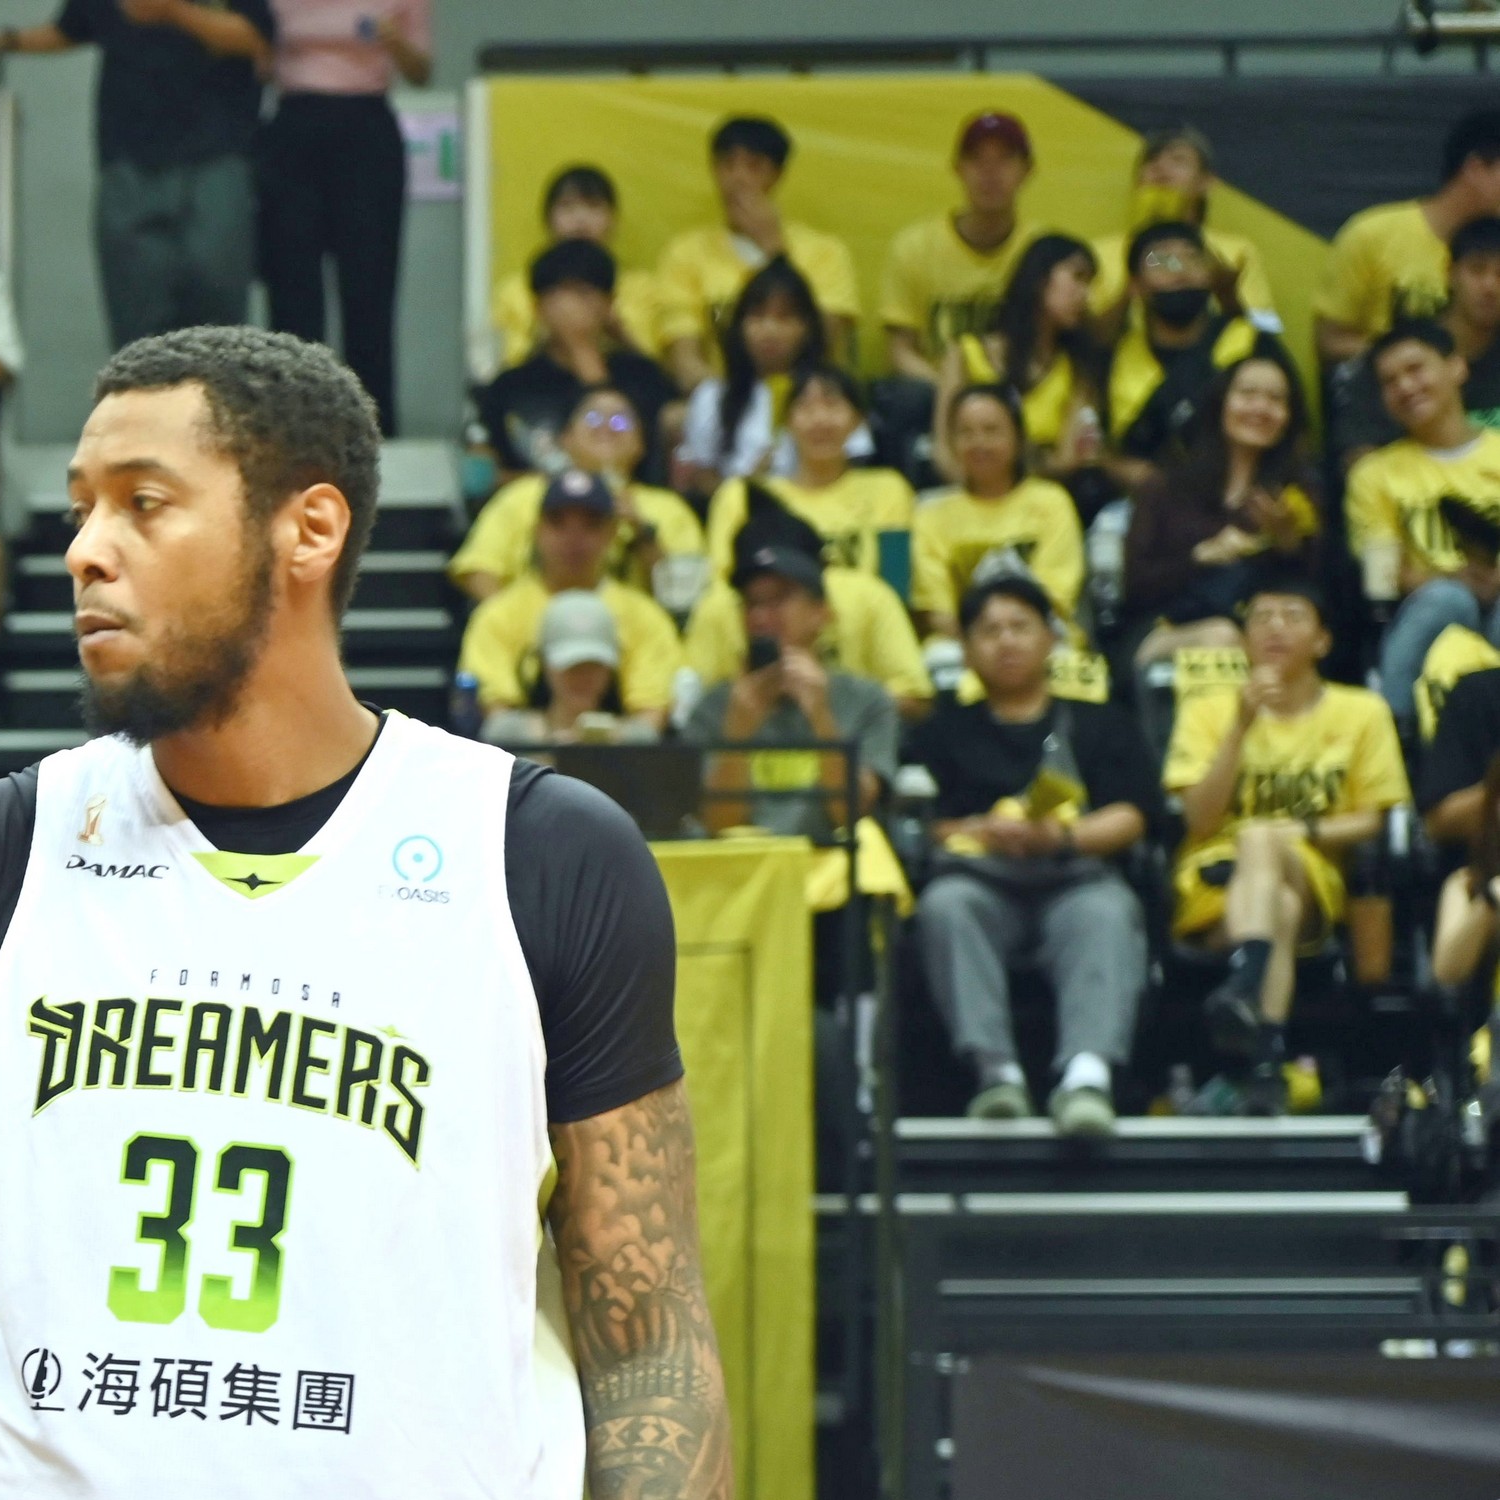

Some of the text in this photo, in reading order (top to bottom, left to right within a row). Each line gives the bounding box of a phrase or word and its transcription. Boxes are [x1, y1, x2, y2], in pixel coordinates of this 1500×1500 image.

[66, 854, 170, 879] DAMAC
[150, 968, 342, 1010] FORMOSA
[27, 995, 432, 1171] DREAMERS
[106, 1129, 296, 1334] 33
[77, 1350, 357, 1437] 海碩集團
